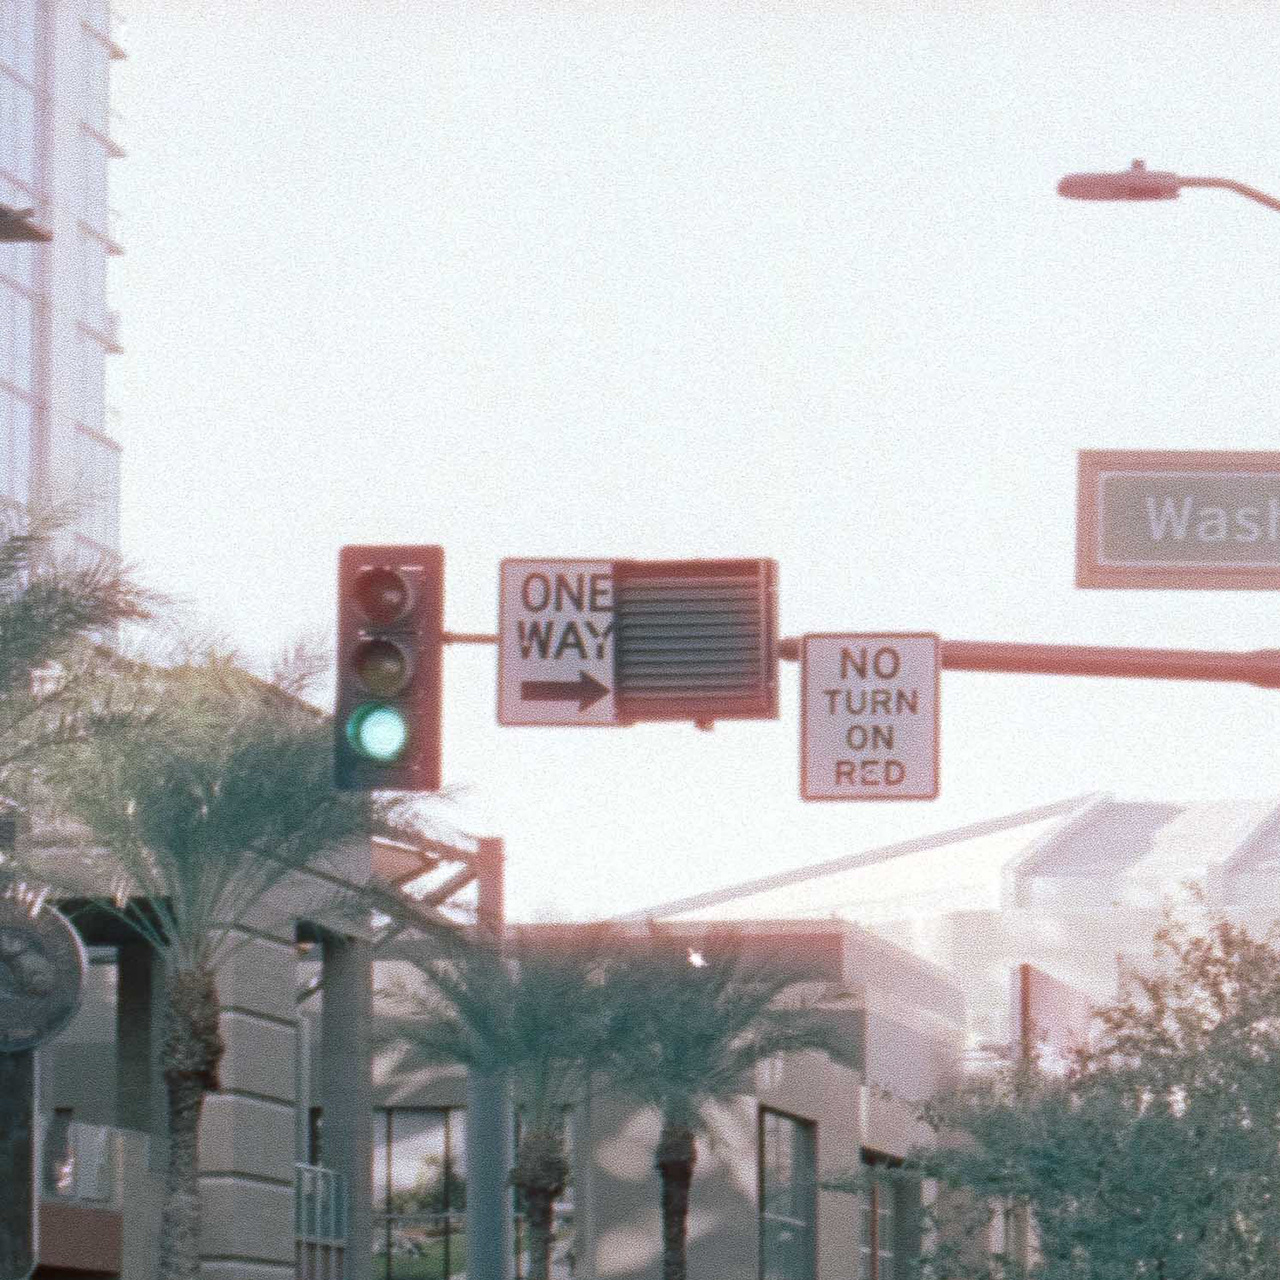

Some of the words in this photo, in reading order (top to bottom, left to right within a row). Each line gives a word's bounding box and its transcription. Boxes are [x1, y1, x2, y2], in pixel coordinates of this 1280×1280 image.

[521, 572, 614, 613] ONE
[516, 619, 614, 660] WAY
[840, 646, 901, 681] NO
[822, 687, 920, 716] TURN
[846, 724, 895, 751] ON
[835, 759, 907, 786] RED
